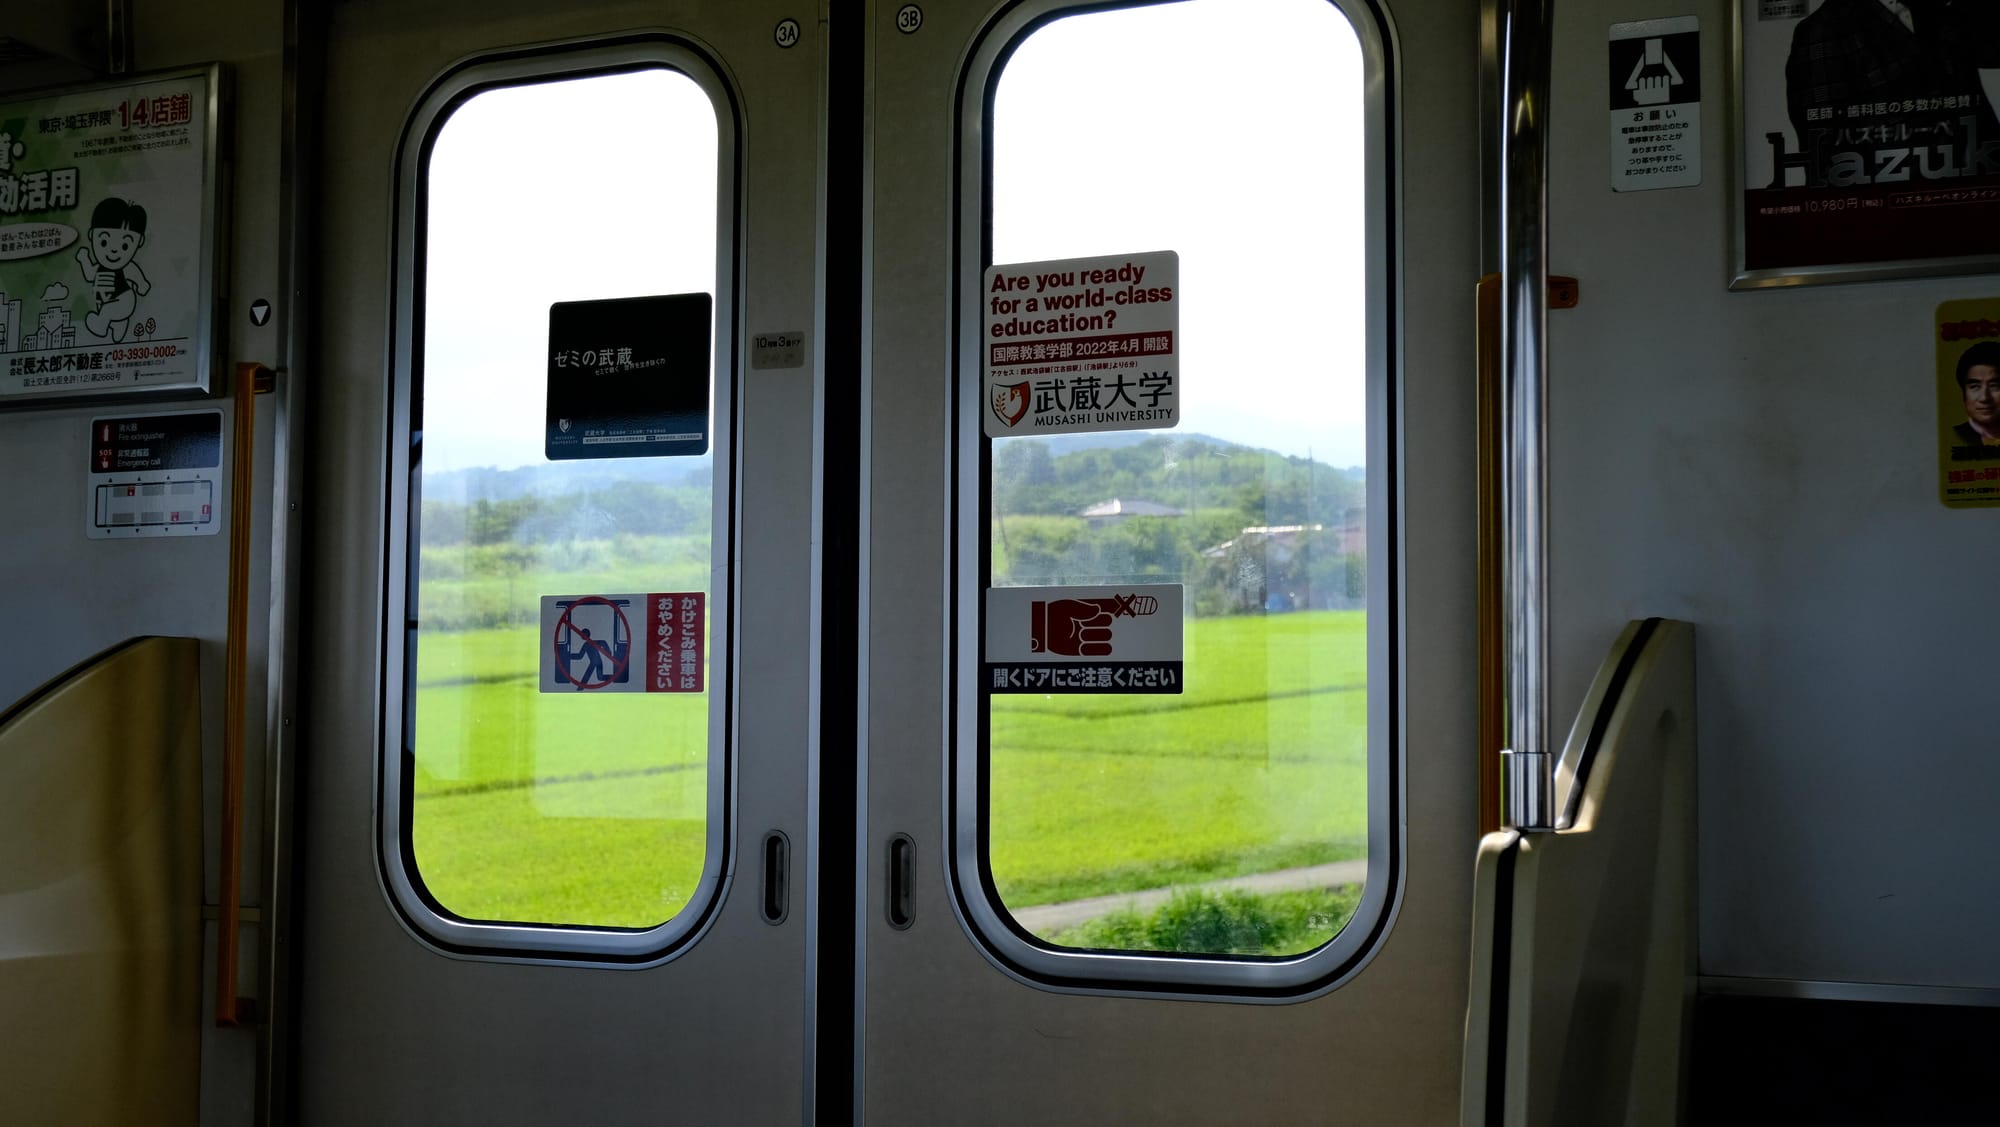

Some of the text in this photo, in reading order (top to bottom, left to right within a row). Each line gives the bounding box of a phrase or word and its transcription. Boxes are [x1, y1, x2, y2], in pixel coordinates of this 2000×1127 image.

[901, 11, 918, 28] 3B
[779, 26, 796, 42] 3A
[119, 92, 191, 130] 14店舗
[1834, 120, 1955, 147] ハズキルーペ
[1625, 165, 1687, 176] おつかまりください
[991, 263, 1145, 293] Are you ready
[991, 286, 1173, 315] for a world-class
[991, 310, 1117, 337] education?
[24, 352, 103, 375] 長太郎不動産
[112, 345, 177, 361] 03-3930-0002
[554, 346, 633, 369] ゼミの武蔵
[993, 336, 1169, 363] 国際教養学部 2022年4月 開設
[1034, 371, 1173, 414] 武蔵大学
[1035, 408, 1173, 427] MUSASHI UNIVERSITY
[99, 449, 113, 457] SOS
[657, 597, 673, 689] おやめください
[681, 596, 697, 689] かけこみ乗車は
[993, 667, 1176, 688] 開くドアにご注意ください
